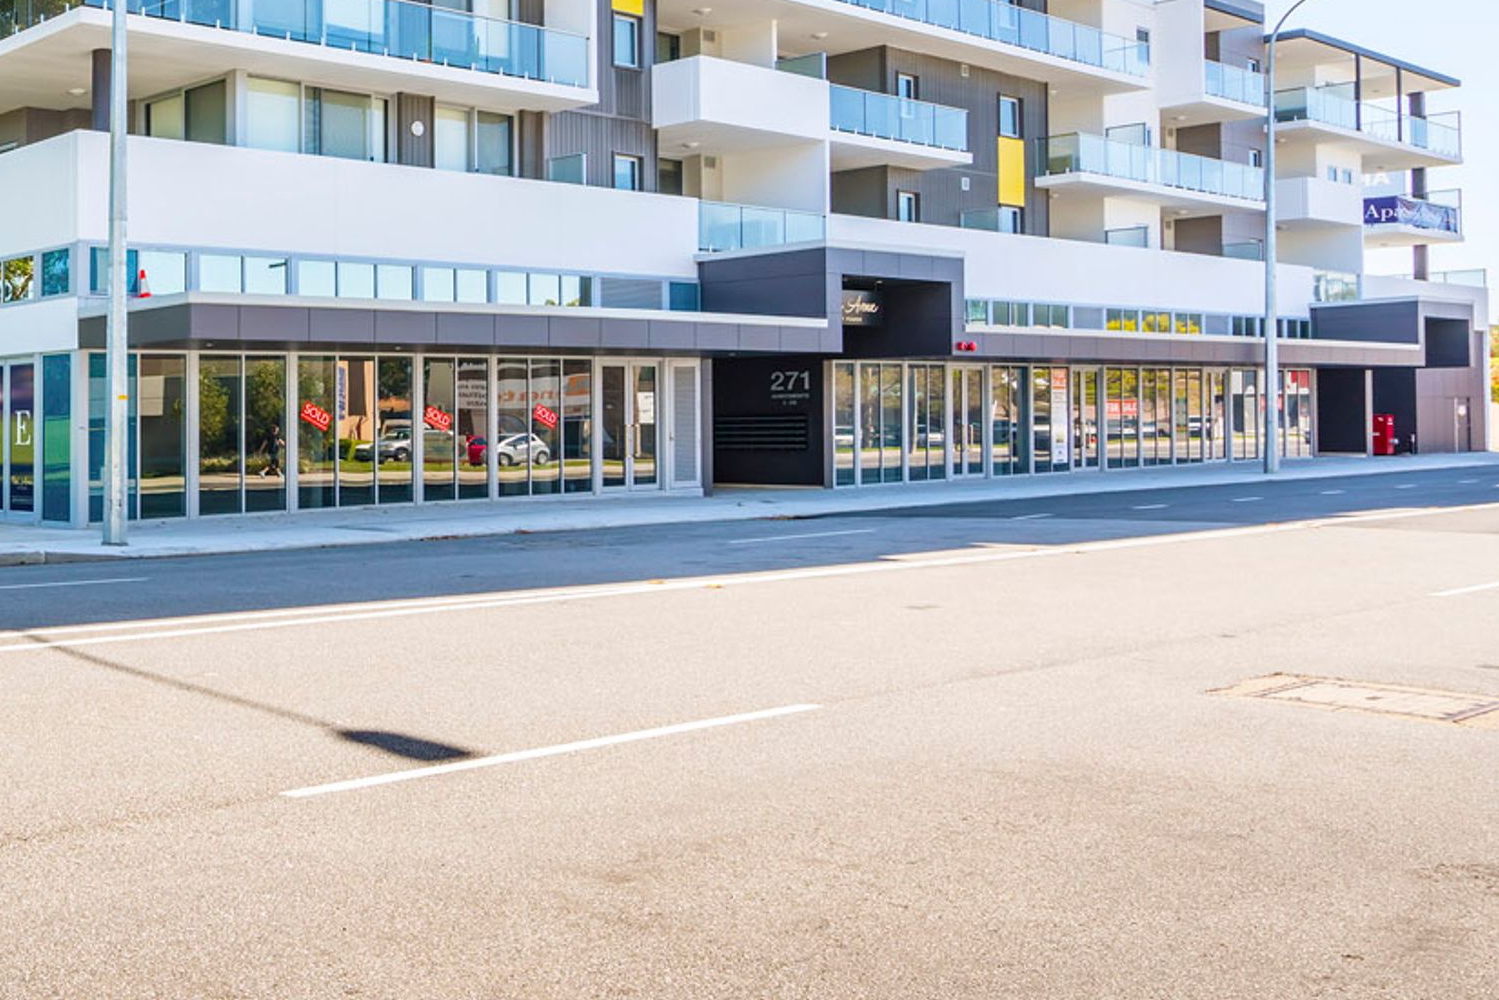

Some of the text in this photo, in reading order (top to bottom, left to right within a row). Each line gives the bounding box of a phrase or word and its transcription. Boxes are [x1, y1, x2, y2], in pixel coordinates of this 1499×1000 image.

[770, 371, 810, 391] 271
[303, 403, 330, 426] SOLD
[425, 406, 452, 426] SOLD
[535, 404, 557, 424] SOLD
